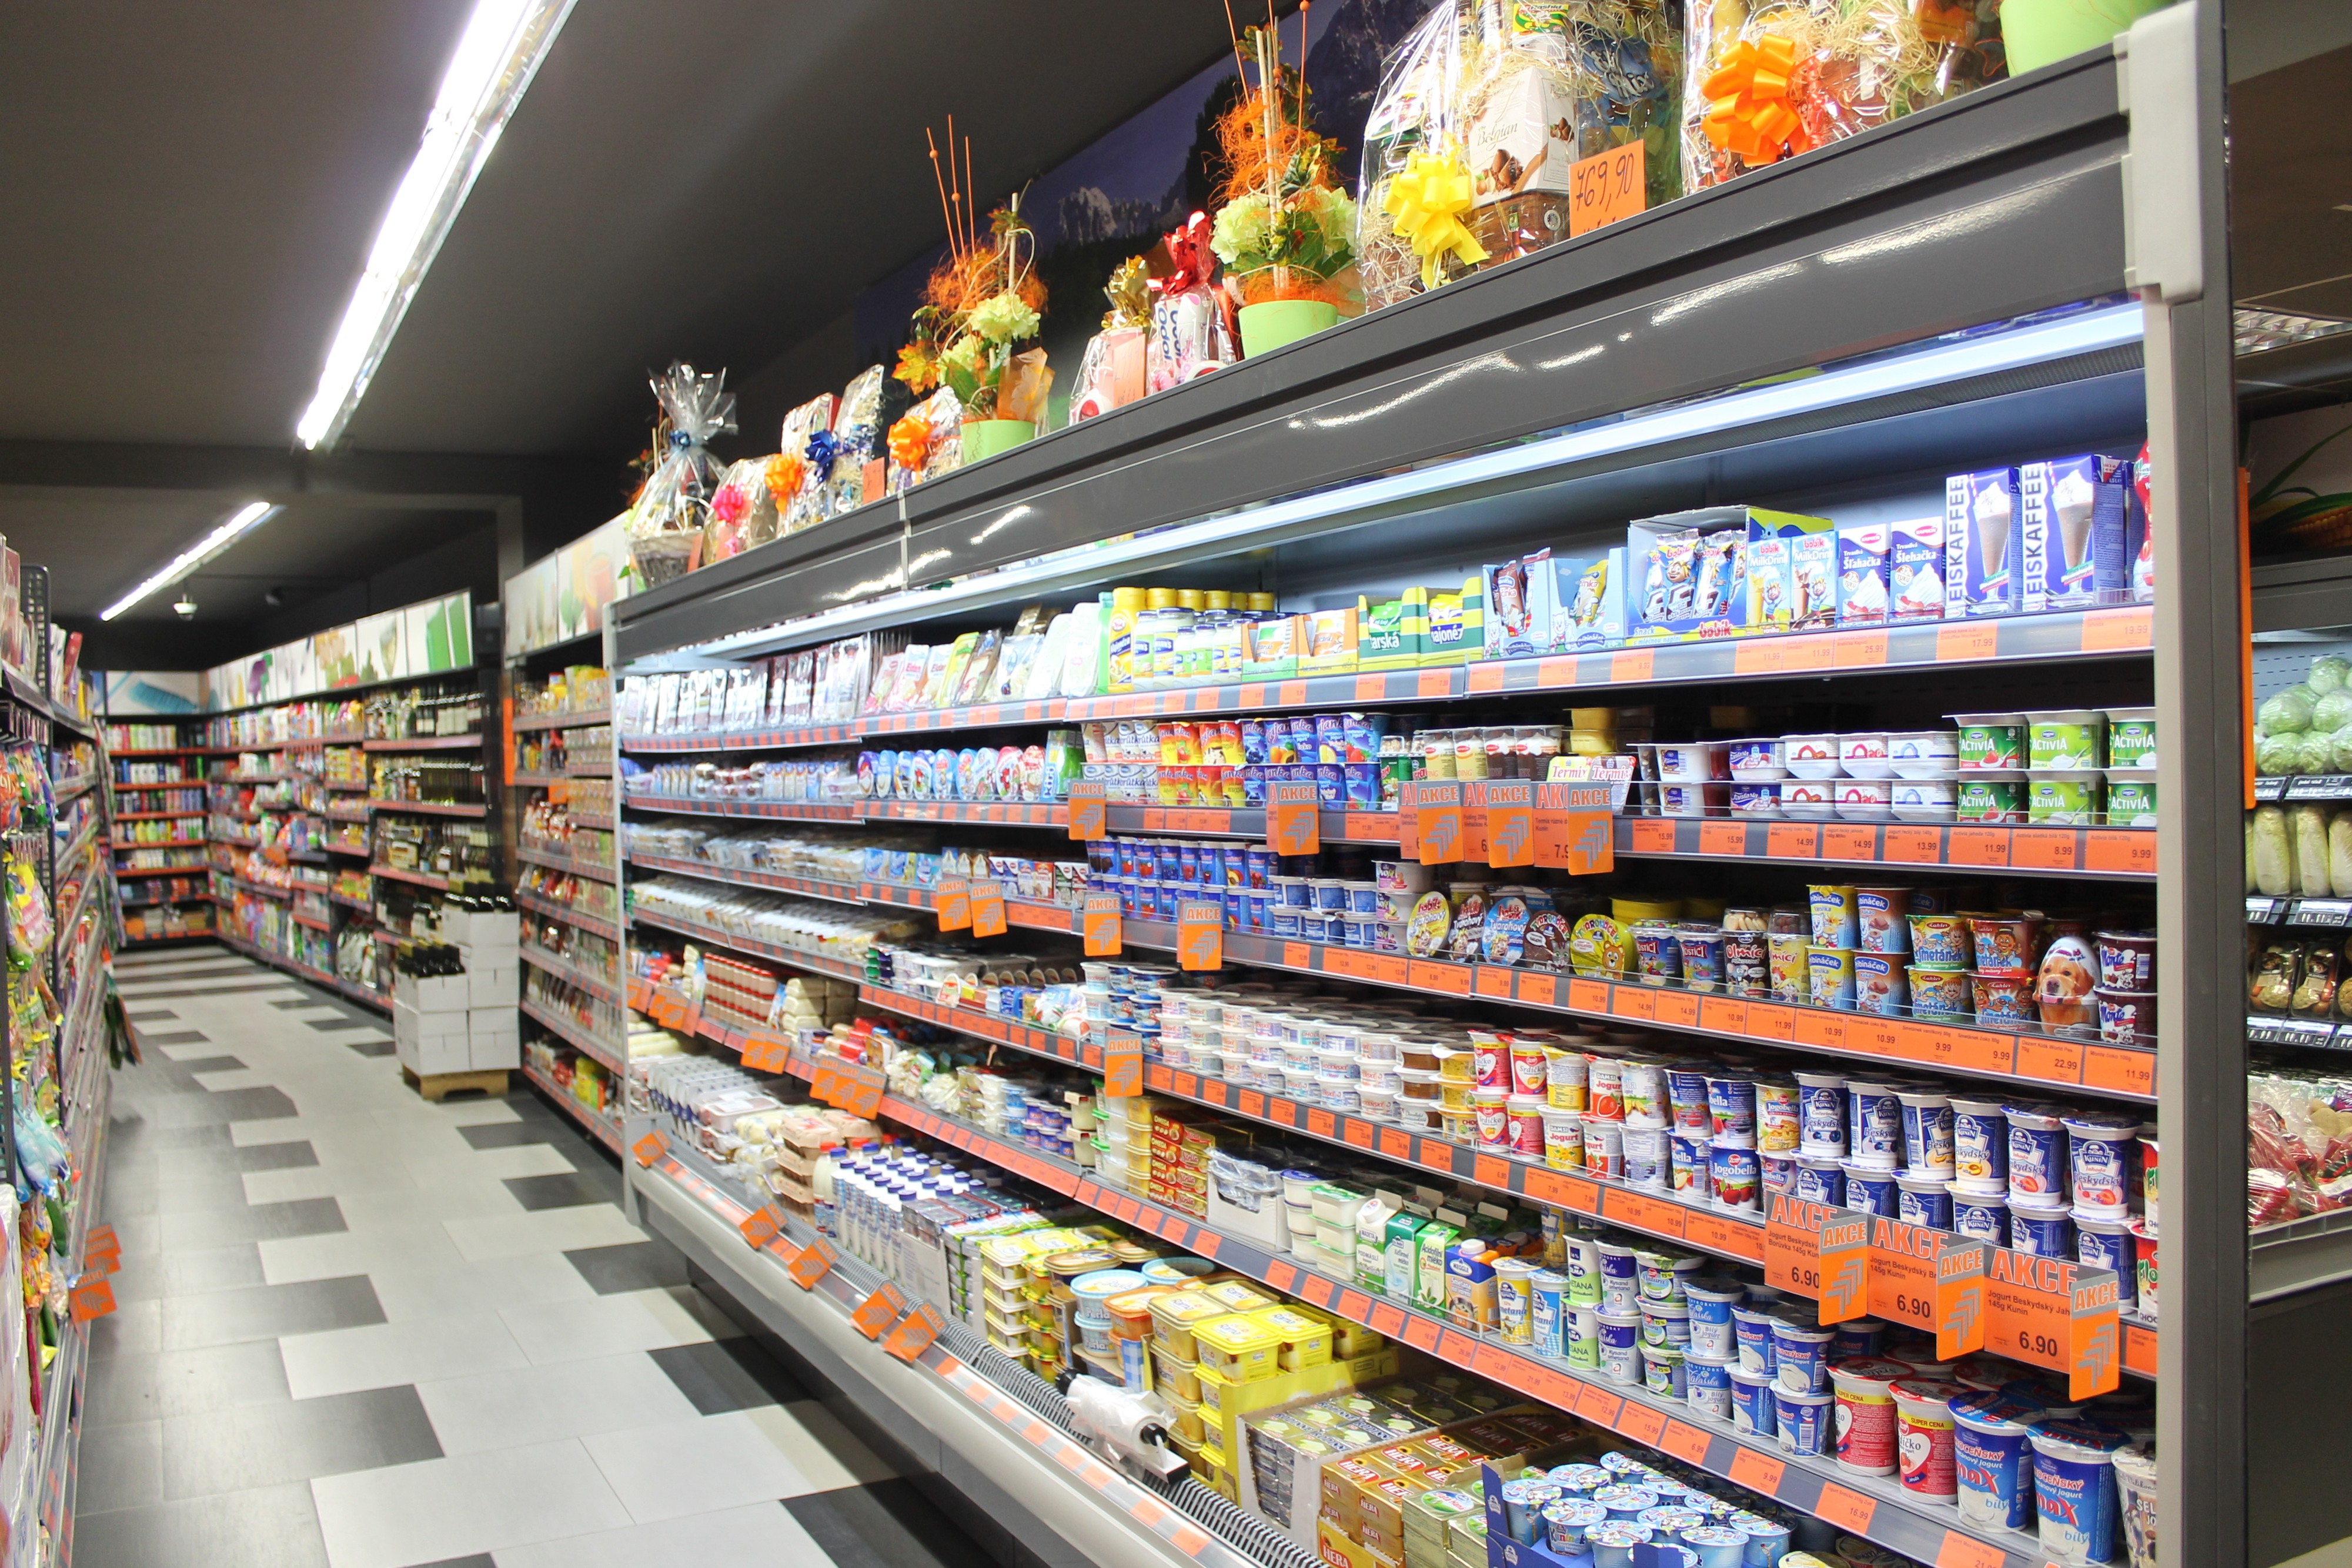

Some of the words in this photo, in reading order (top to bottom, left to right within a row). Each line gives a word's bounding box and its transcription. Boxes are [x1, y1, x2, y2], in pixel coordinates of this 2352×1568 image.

[1158, 307, 1172, 360] Odol
[2025, 466, 2042, 595] EISKAFFEE
[1949, 479, 1964, 602] EISKAFFEE
[1634, 626, 1655, 636] Snack
[2124, 625, 2147, 634] 19.99
[1972, 638, 1993, 647] 17.99
[1961, 738, 1994, 751] ACTIVIA
[2032, 737, 2067, 750] ACTIVIA
[2114, 734, 2155, 748] ACTIVIA
[1551, 764, 1586, 778] Termix
[1591, 764, 1630, 781] Termix
[1073, 783, 1103, 795] AKCE
[1280, 786, 1317, 801] AKCE
[1419, 786, 1458, 804] AKCE
[1489, 785, 1529, 803] AKCE
[1571, 788, 1610, 806] AKCE
[1962, 795, 1996, 808] ACTIVIA
[2032, 795, 2065, 808] ACTIVIA
[2112, 796, 2150, 810] ACTIVIA
[1727, 835, 1743, 844] 15.99
[1796, 838, 1813, 846] 14.99
[1853, 840, 1872, 848] 14.99
[1917, 842, 1936, 851] 13.99
[1984, 844, 2006, 852] 11.99
[2054, 847, 2072, 855] 8.99
[2132, 850, 2151, 858] 9.99
[972, 884, 1001, 897] AKCE
[1088, 898, 1120, 910] AKCE
[1186, 907, 1221, 920] AKCE
[2101, 950, 2124, 966] Monte
[1638, 1003, 1652, 1011] 14.99
[1681, 1007, 1695, 1016] 14.99
[1728, 1014, 1743, 1022] 10.99
[2100, 1005, 2124, 1022] Monte
[1775, 1021, 1791, 1029] 11.99
[1824, 1027, 1842, 1037] 10.99
[1876, 1034, 1895, 1044] 10.99
[1108, 1039, 1141, 1052] AKCE
[1935, 1042, 1951, 1052] 9.99
[1993, 1051, 2010, 1060] 9.99
[2054, 1059, 2077, 1070] 22.99
[2126, 1069, 2150, 1080] 11.99
[1767, 1103, 1799, 1112] Jogobella
[1154, 1115, 1170, 1126] OMEGA
[1151, 1139, 1167, 1149] OMEGA
[1549, 1134, 1579, 1142] Jogurt
[1152, 1159, 1167, 1171] OMEGA
[1714, 1163, 1756, 1176] Jogobella
[1150, 1182, 1164, 1192] OMEGA
[1548, 1186, 1558, 1194] 7.99
[1585, 1195, 1595, 1203] 7.99
[1627, 1207, 1642, 1216] 10.99
[1666, 1218, 1682, 1228] 10.99
[1710, 1231, 1727, 1242] 10.99
[1769, 1231, 1787, 1242] Jogurt
[1788, 1235, 1819, 1250] Beskydský
[1823, 1222, 1867, 1248] AKCE
[1872, 1217, 1948, 1261] AKCE
[1792, 1246, 1806, 1257] 145g
[1870, 1255, 1891, 1268] Jogurt
[1892, 1261, 1927, 1278] Beskydský
[1940, 1248, 1983, 1279] AKCE
[1792, 1266, 1819, 1289] 6.90
[1870, 1265, 1886, 1276] 145g
[1887, 1268, 1906, 1280] Kunín
[1990, 1249, 2077, 1297] AKCE
[1988, 1289, 2011, 1302] Jogurt
[2012, 1295, 2054, 1313] Beskydský
[2074, 1281, 2118, 1312] AKCE
[1897, 1295, 1930, 1318] 6.90
[1988, 1299, 2005, 1312] 145g
[2007, 1304, 2027, 1316] Kunín
[1087, 1308, 1110, 1320] Perla
[2019, 1331, 2057, 1357] 6.90
[1837, 1389, 1849, 1398] SUPER
[1601, 1406, 1615, 1417] 12.99
[1911, 1418, 1927, 1426] SUPER
[1644, 1423, 1659, 1434] 15.99
[1429, 1438, 1464, 1456] HERA
[1691, 1443, 1704, 1454] 6.99
[1387, 1450, 1419, 1469] HERA
[1980, 1459, 2003, 1469] jogurt
[1341, 1460, 1375, 1480] HERA
[1763, 1473, 1777, 1483] 9.99
[2058, 1489, 2083, 1499] jogurt
[1361, 1500, 1378, 1513] HERA
[1985, 1499, 2009, 1510] bílý
[1850, 1507, 1868, 1520] 16.99
[1362, 1526, 1379, 1540] HERA
[2064, 1530, 2089, 1544] bílý
